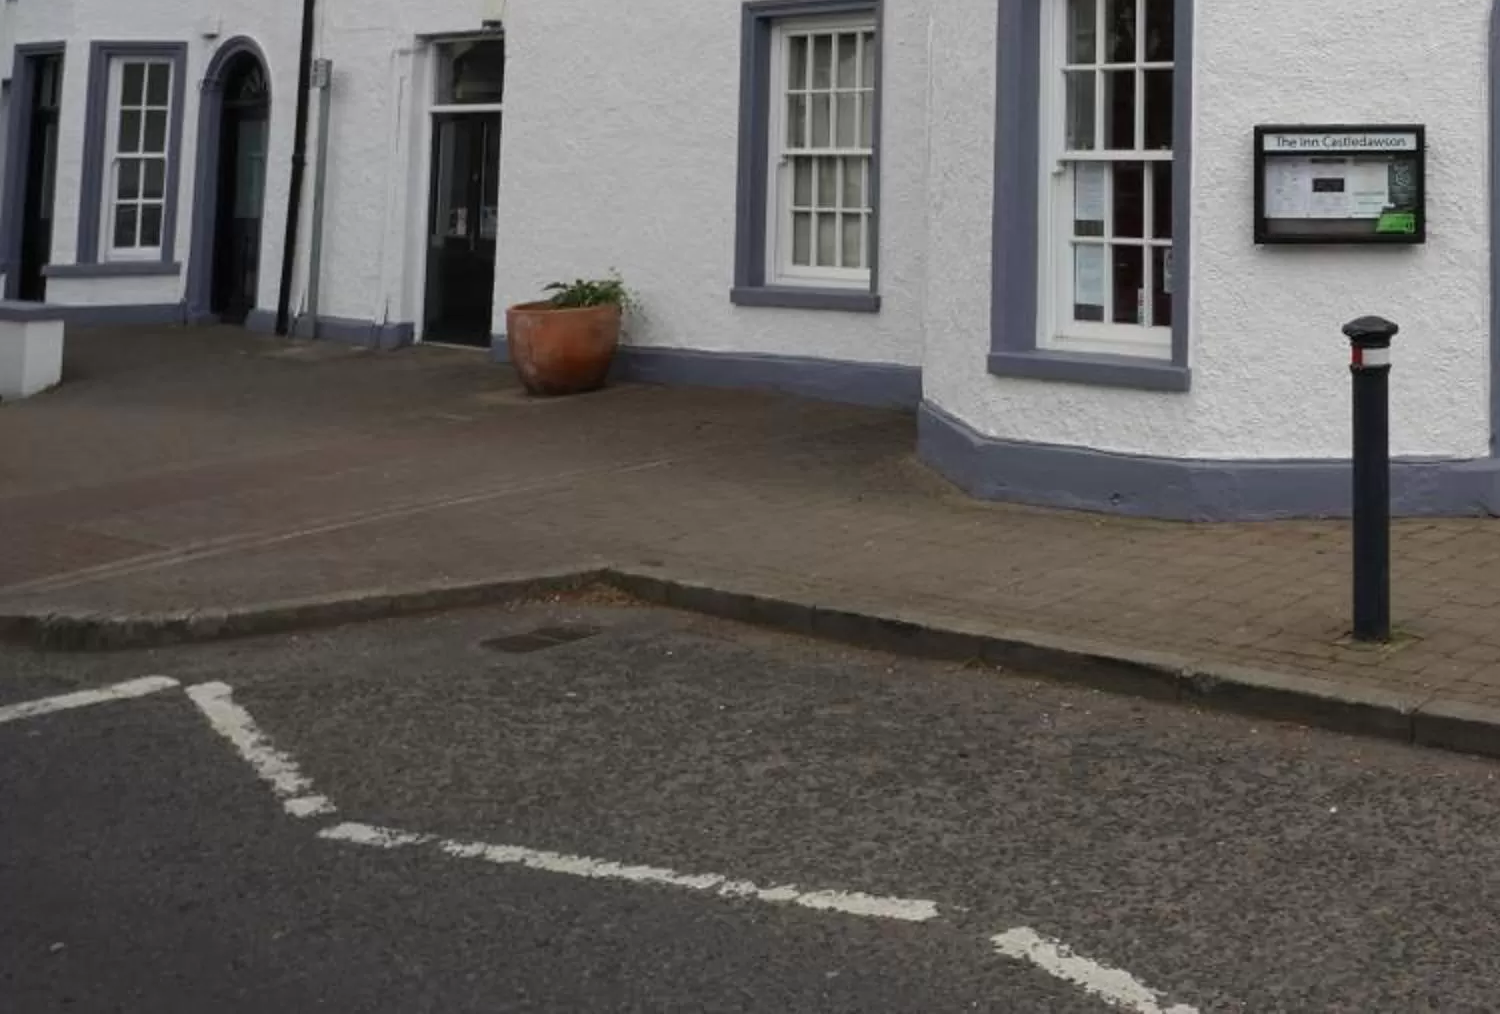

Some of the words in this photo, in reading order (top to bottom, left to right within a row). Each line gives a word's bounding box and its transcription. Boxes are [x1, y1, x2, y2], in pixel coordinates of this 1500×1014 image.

[1276, 136, 1297, 148] The
[1300, 136, 1319, 147] Inn
[1322, 136, 1406, 147] Castledawson
